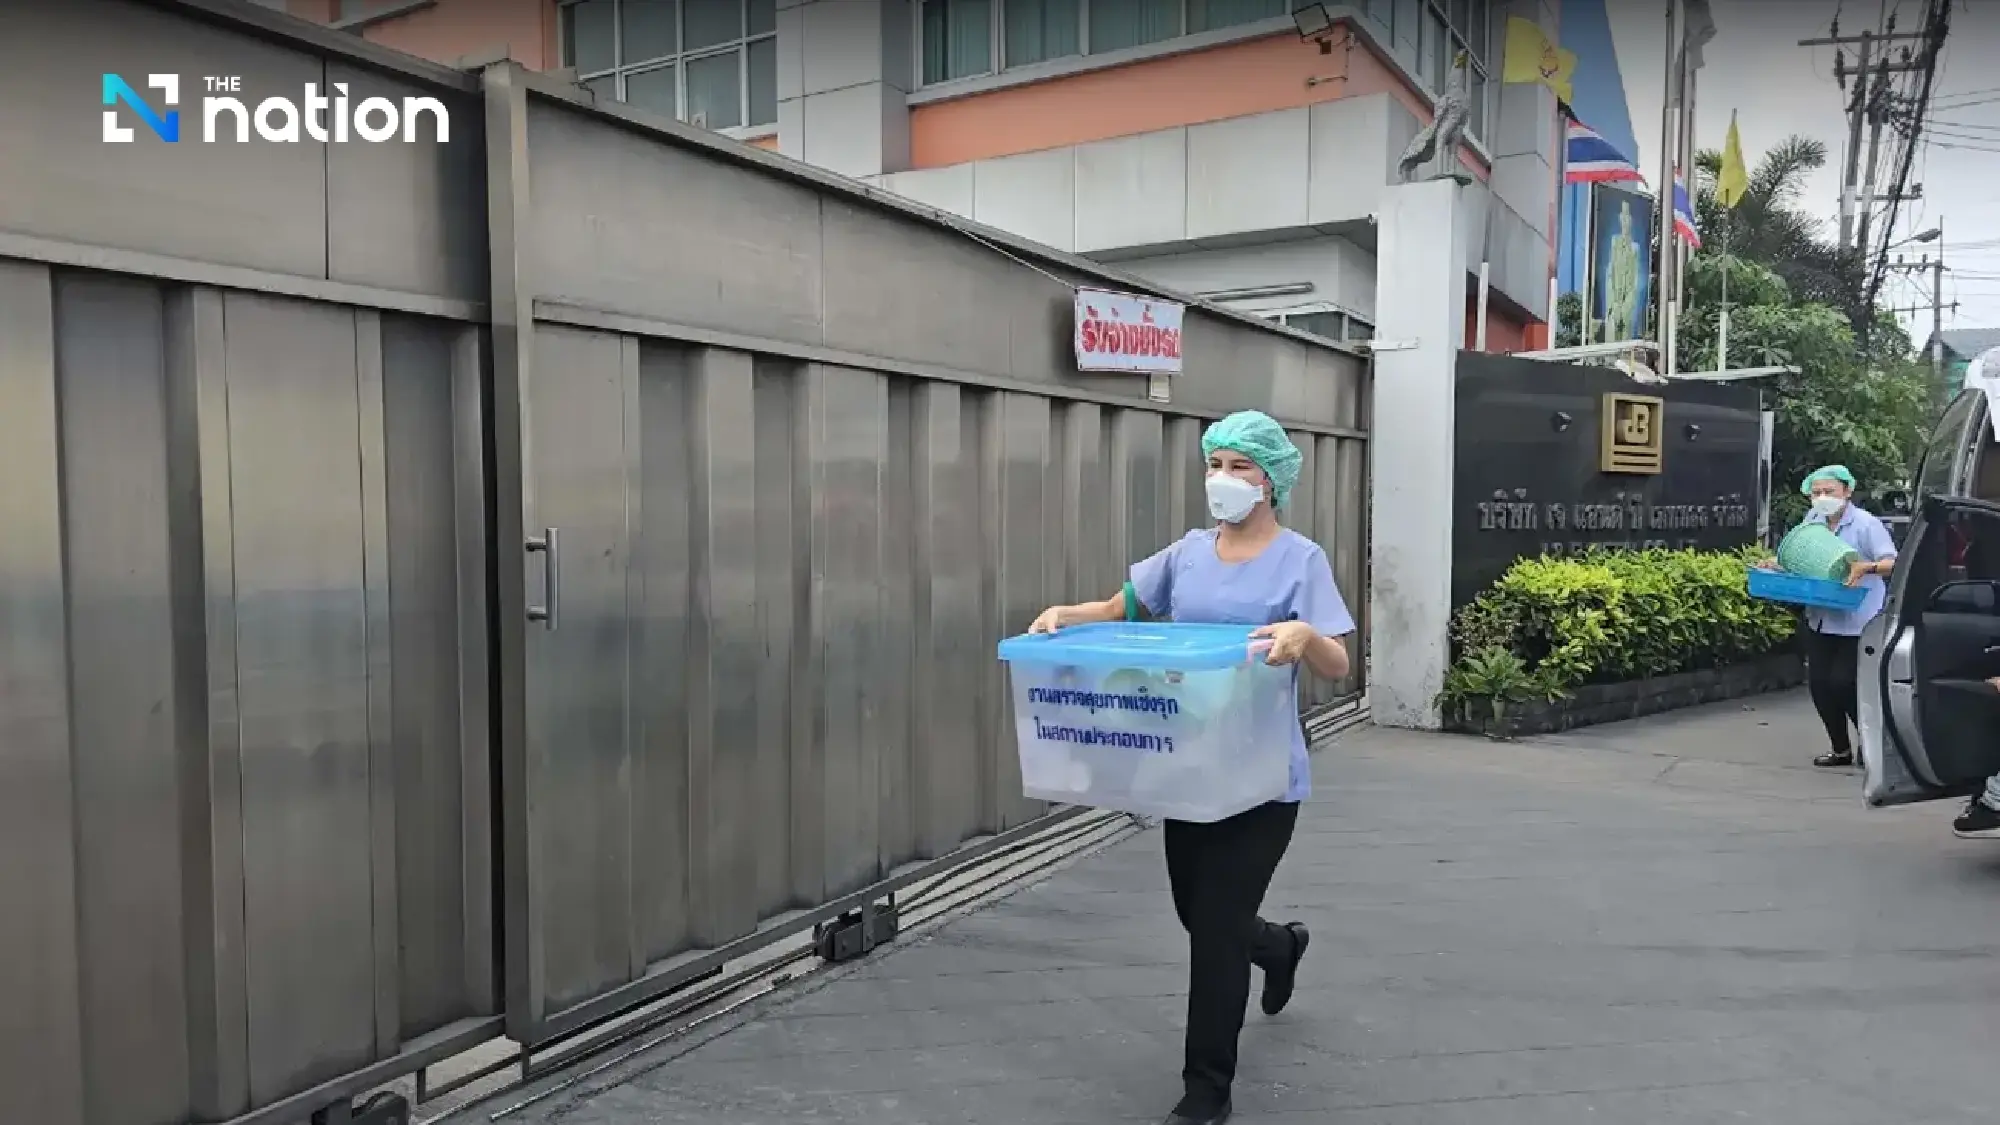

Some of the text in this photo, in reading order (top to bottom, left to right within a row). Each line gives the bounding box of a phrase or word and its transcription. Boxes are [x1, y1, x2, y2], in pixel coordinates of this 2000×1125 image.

[1477, 488, 1538, 530] บริษัท
[1027, 685, 1179, 721] งานตรวจสุขภาพเชิงรุก
[1033, 715, 1175, 753] ในสถานประกอบการ
